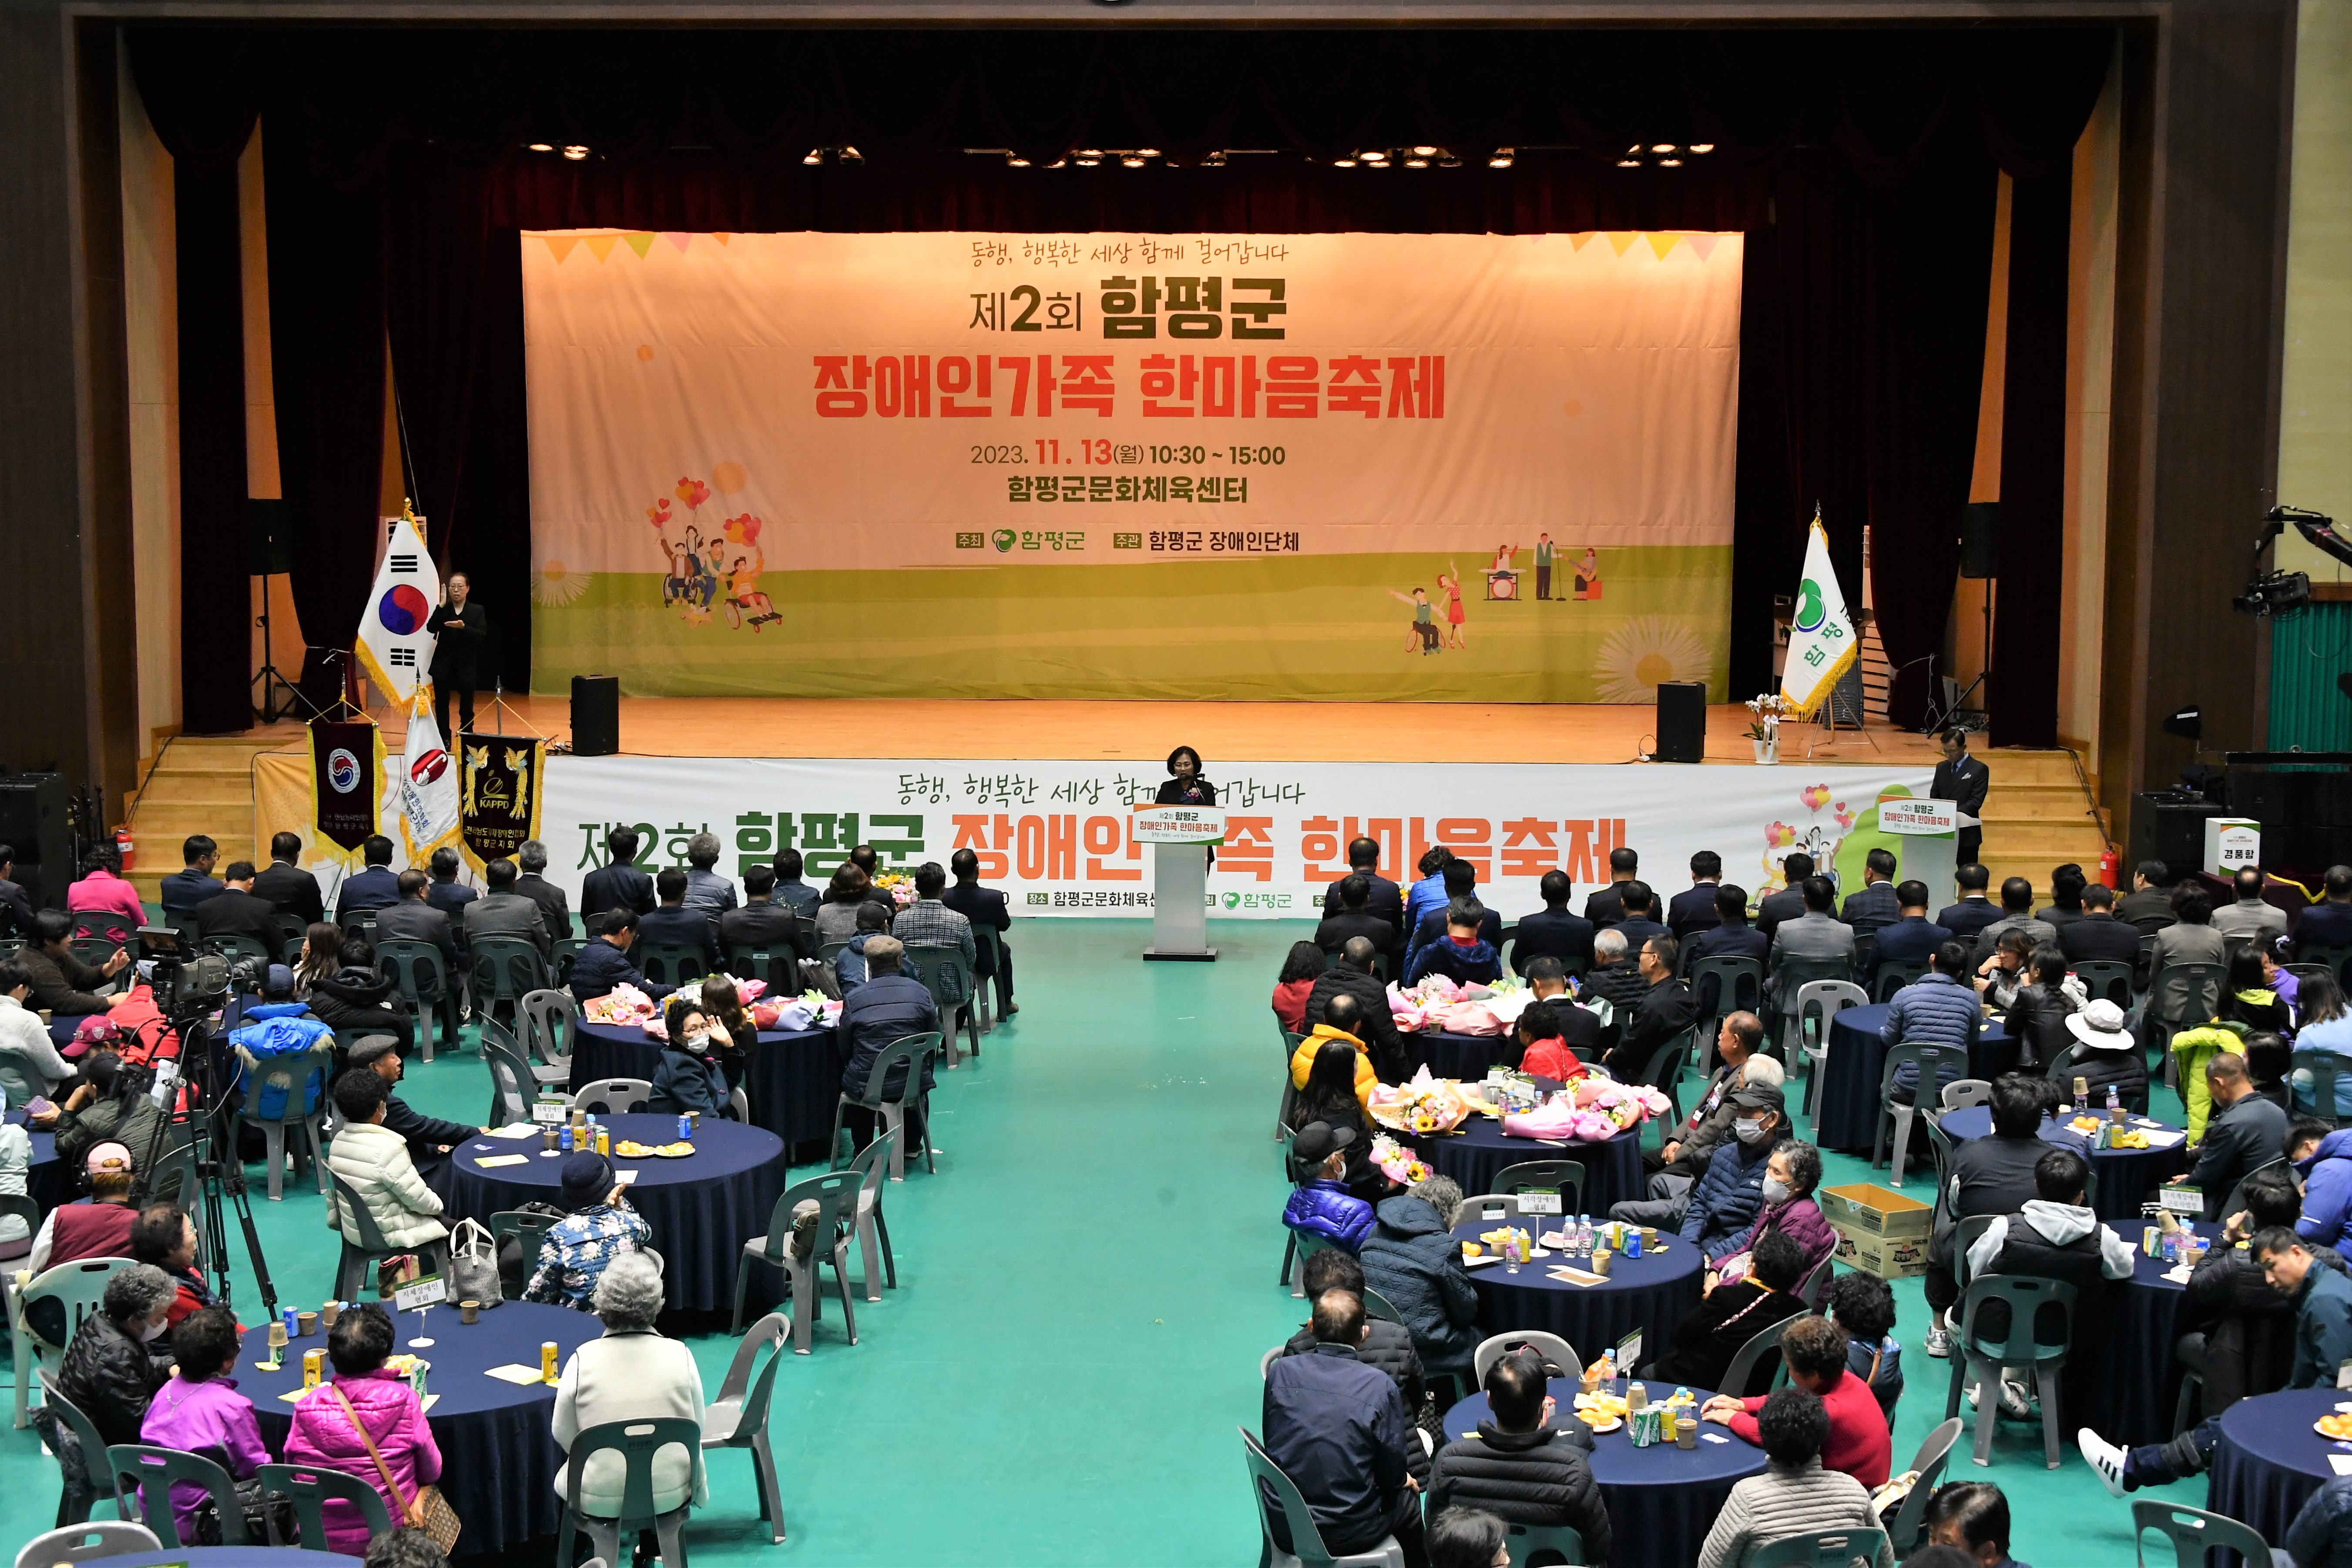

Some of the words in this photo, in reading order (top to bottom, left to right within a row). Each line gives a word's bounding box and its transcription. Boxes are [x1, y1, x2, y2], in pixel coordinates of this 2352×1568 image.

[971, 240, 1012, 267] 동행,
[1023, 240, 1082, 268] 행복한
[1090, 242, 1132, 264] 세상
[1138, 237, 1184, 265] 함께
[1195, 238, 1290, 265] 걸어갑니다
[969, 285, 1082, 332] 제2회
[1100, 275, 1287, 340] 함평군
[812, 354, 1116, 419] 장애인가족
[1139, 352, 1446, 420] 한마음축제
[970, 444, 1029, 465] 2023.
[1149, 445, 1206, 465] 10:30
[1211, 451, 1223, 460] ~
[1229, 445, 1286, 465] 15:00
[1007, 475, 1248, 504] 함평군문화체육센터
[958, 533, 981, 547] 주최
[1021, 530, 1085, 551] 함평군
[1116, 534, 1140, 547] 주관
[1148, 530, 1203, 552] 함평군
[1209, 531, 1300, 553] 장애인단체
[897, 773, 951, 805] 동행,
[963, 774, 1039, 808] 행복한
[1050, 777, 1104, 806] 세상
[1213, 776, 1305, 808] 어갑니다
[480, 799, 509, 809] KAPPD
[1914, 804, 1934, 815] 함평군
[1175, 812, 1199, 821] 함평군
[1884, 812, 1916, 823] 장애인가족
[1918, 815, 1950, 826] 한마음축제
[1140, 821, 1177, 831] 장애인가족
[1180, 823, 1218, 833] 한마음축제
[735, 811, 925, 878] 함평군
[951, 813, 1273, 882] 장애인족
[1301, 815, 1626, 885] 한마음축제
[2224, 849, 2254, 859] 경품함
[1029, 893, 1047, 904] 장소
[1053, 891, 1155, 907] 함평군문화체육
[1244, 893, 1292, 909] 함평군
[1523, 1195, 1556, 1203] 시각장애인
[402, 1282, 439, 1298] 지체장애인
